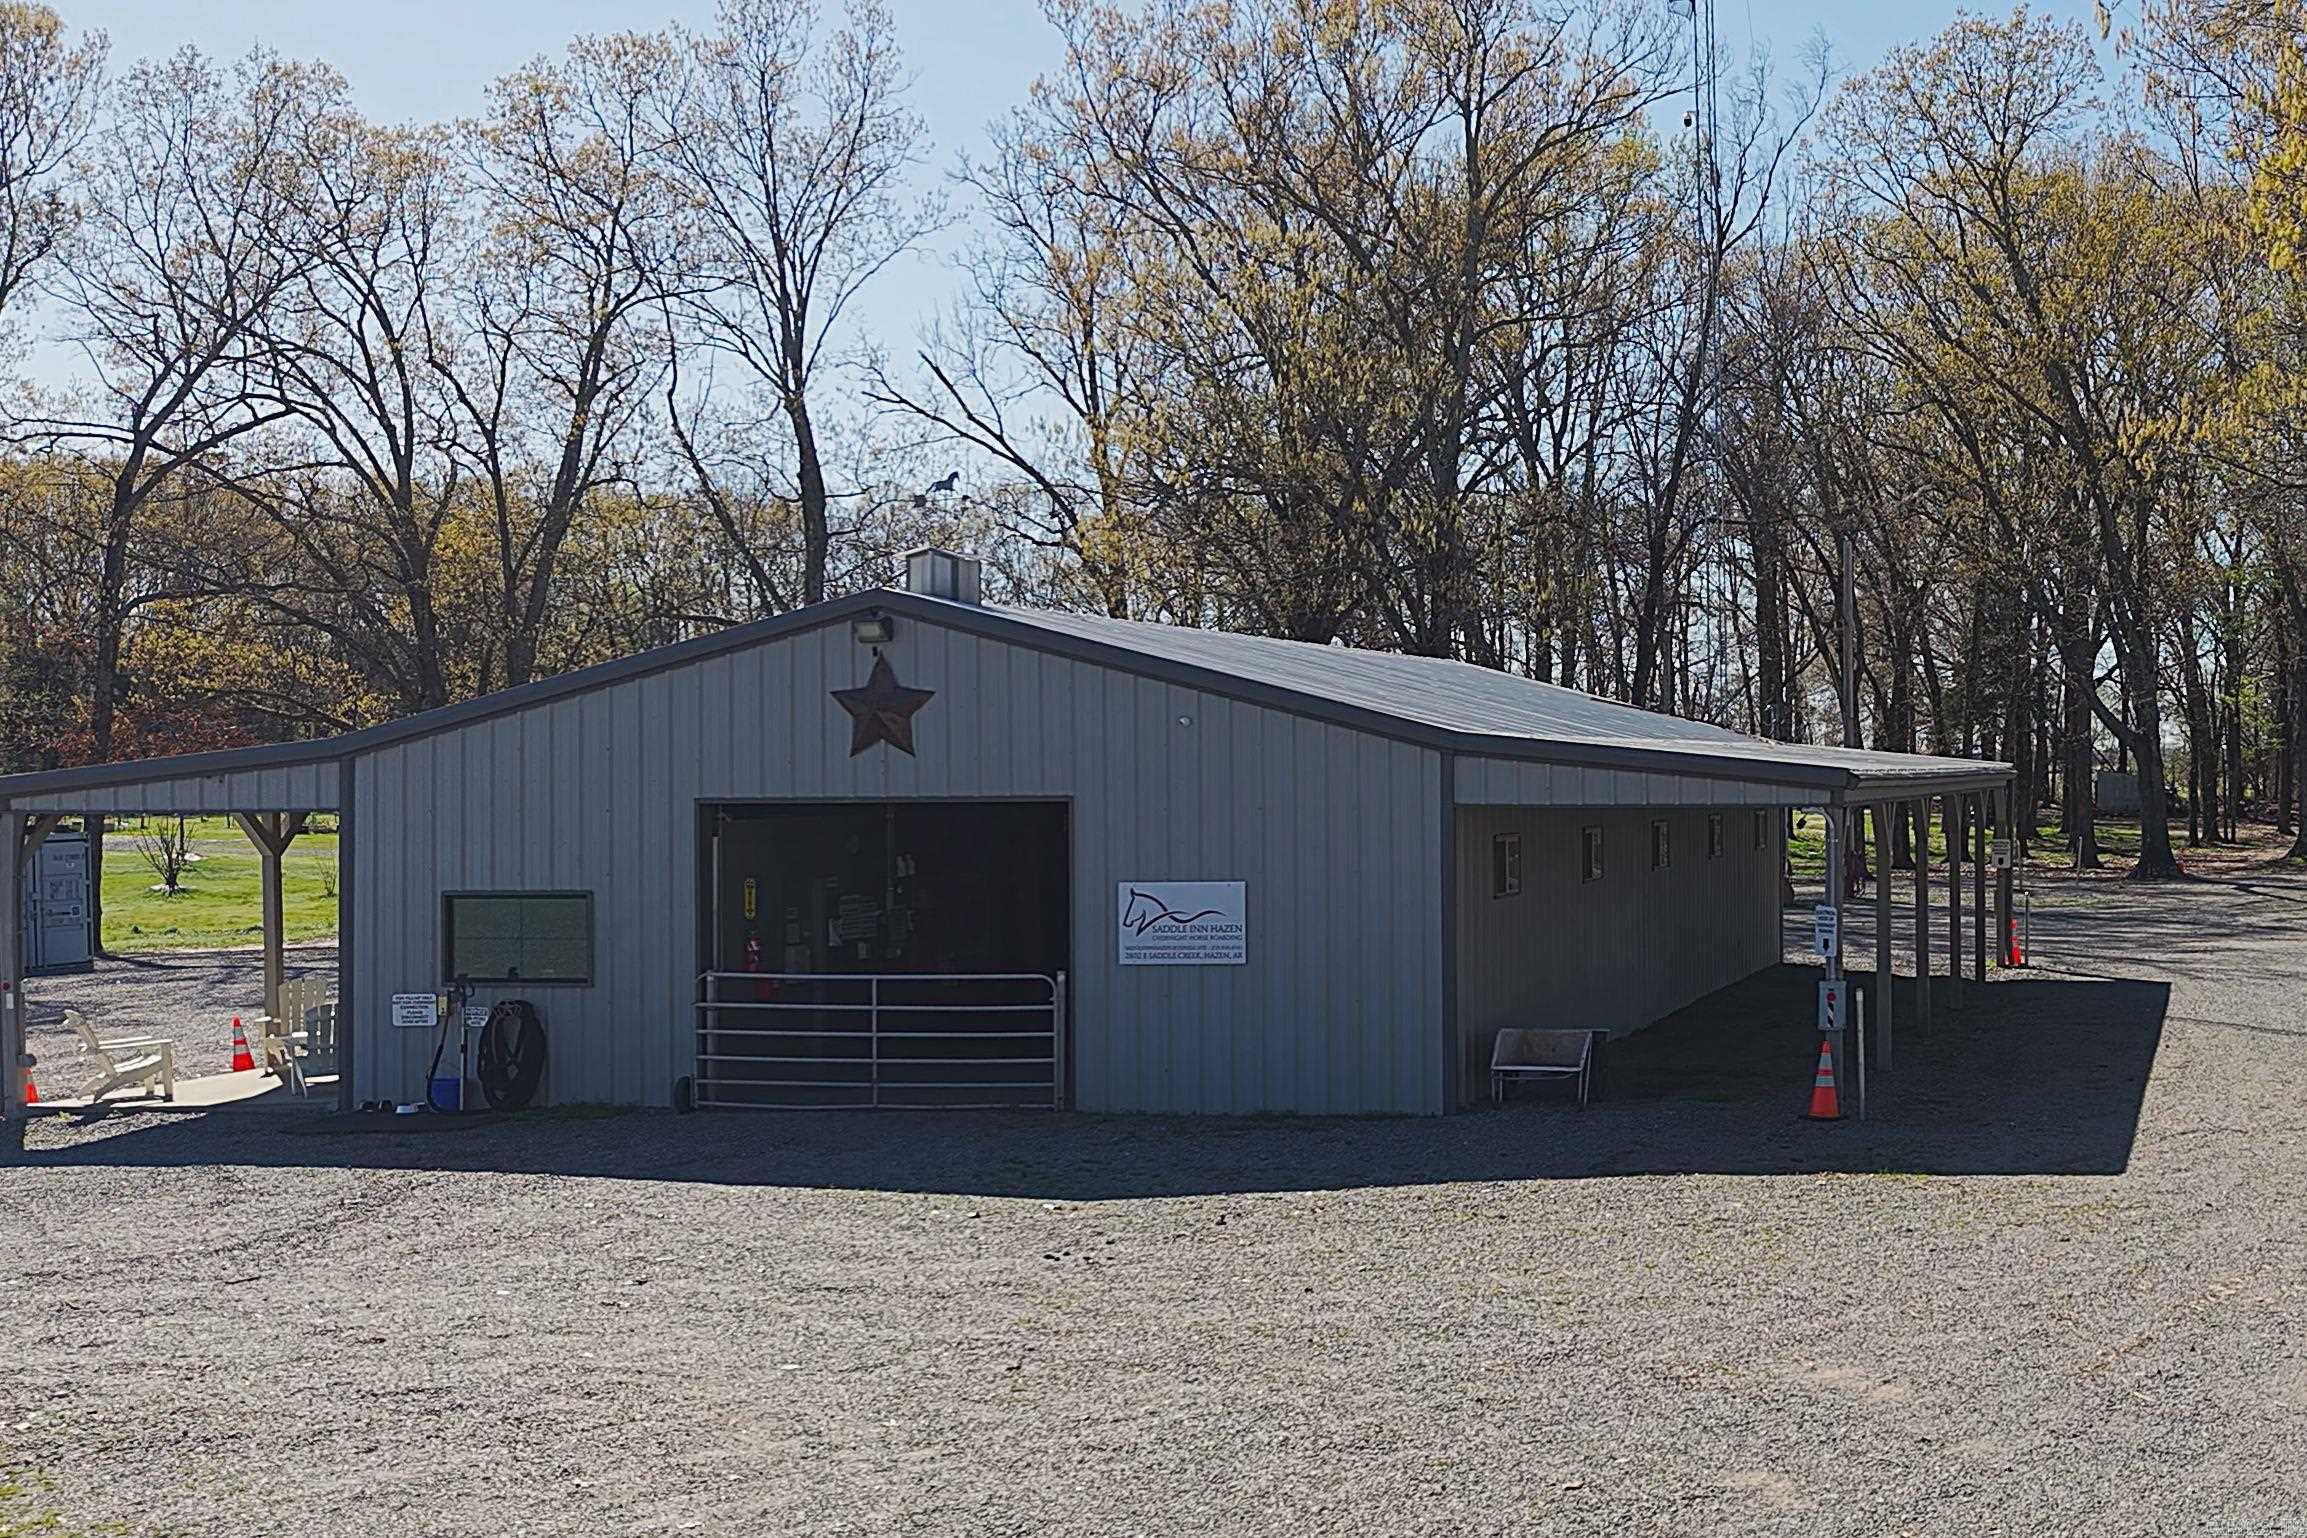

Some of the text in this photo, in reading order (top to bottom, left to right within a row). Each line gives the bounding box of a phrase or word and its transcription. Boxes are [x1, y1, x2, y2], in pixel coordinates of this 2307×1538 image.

[1152, 924, 1243, 933] SADDLE INN HAZEN
